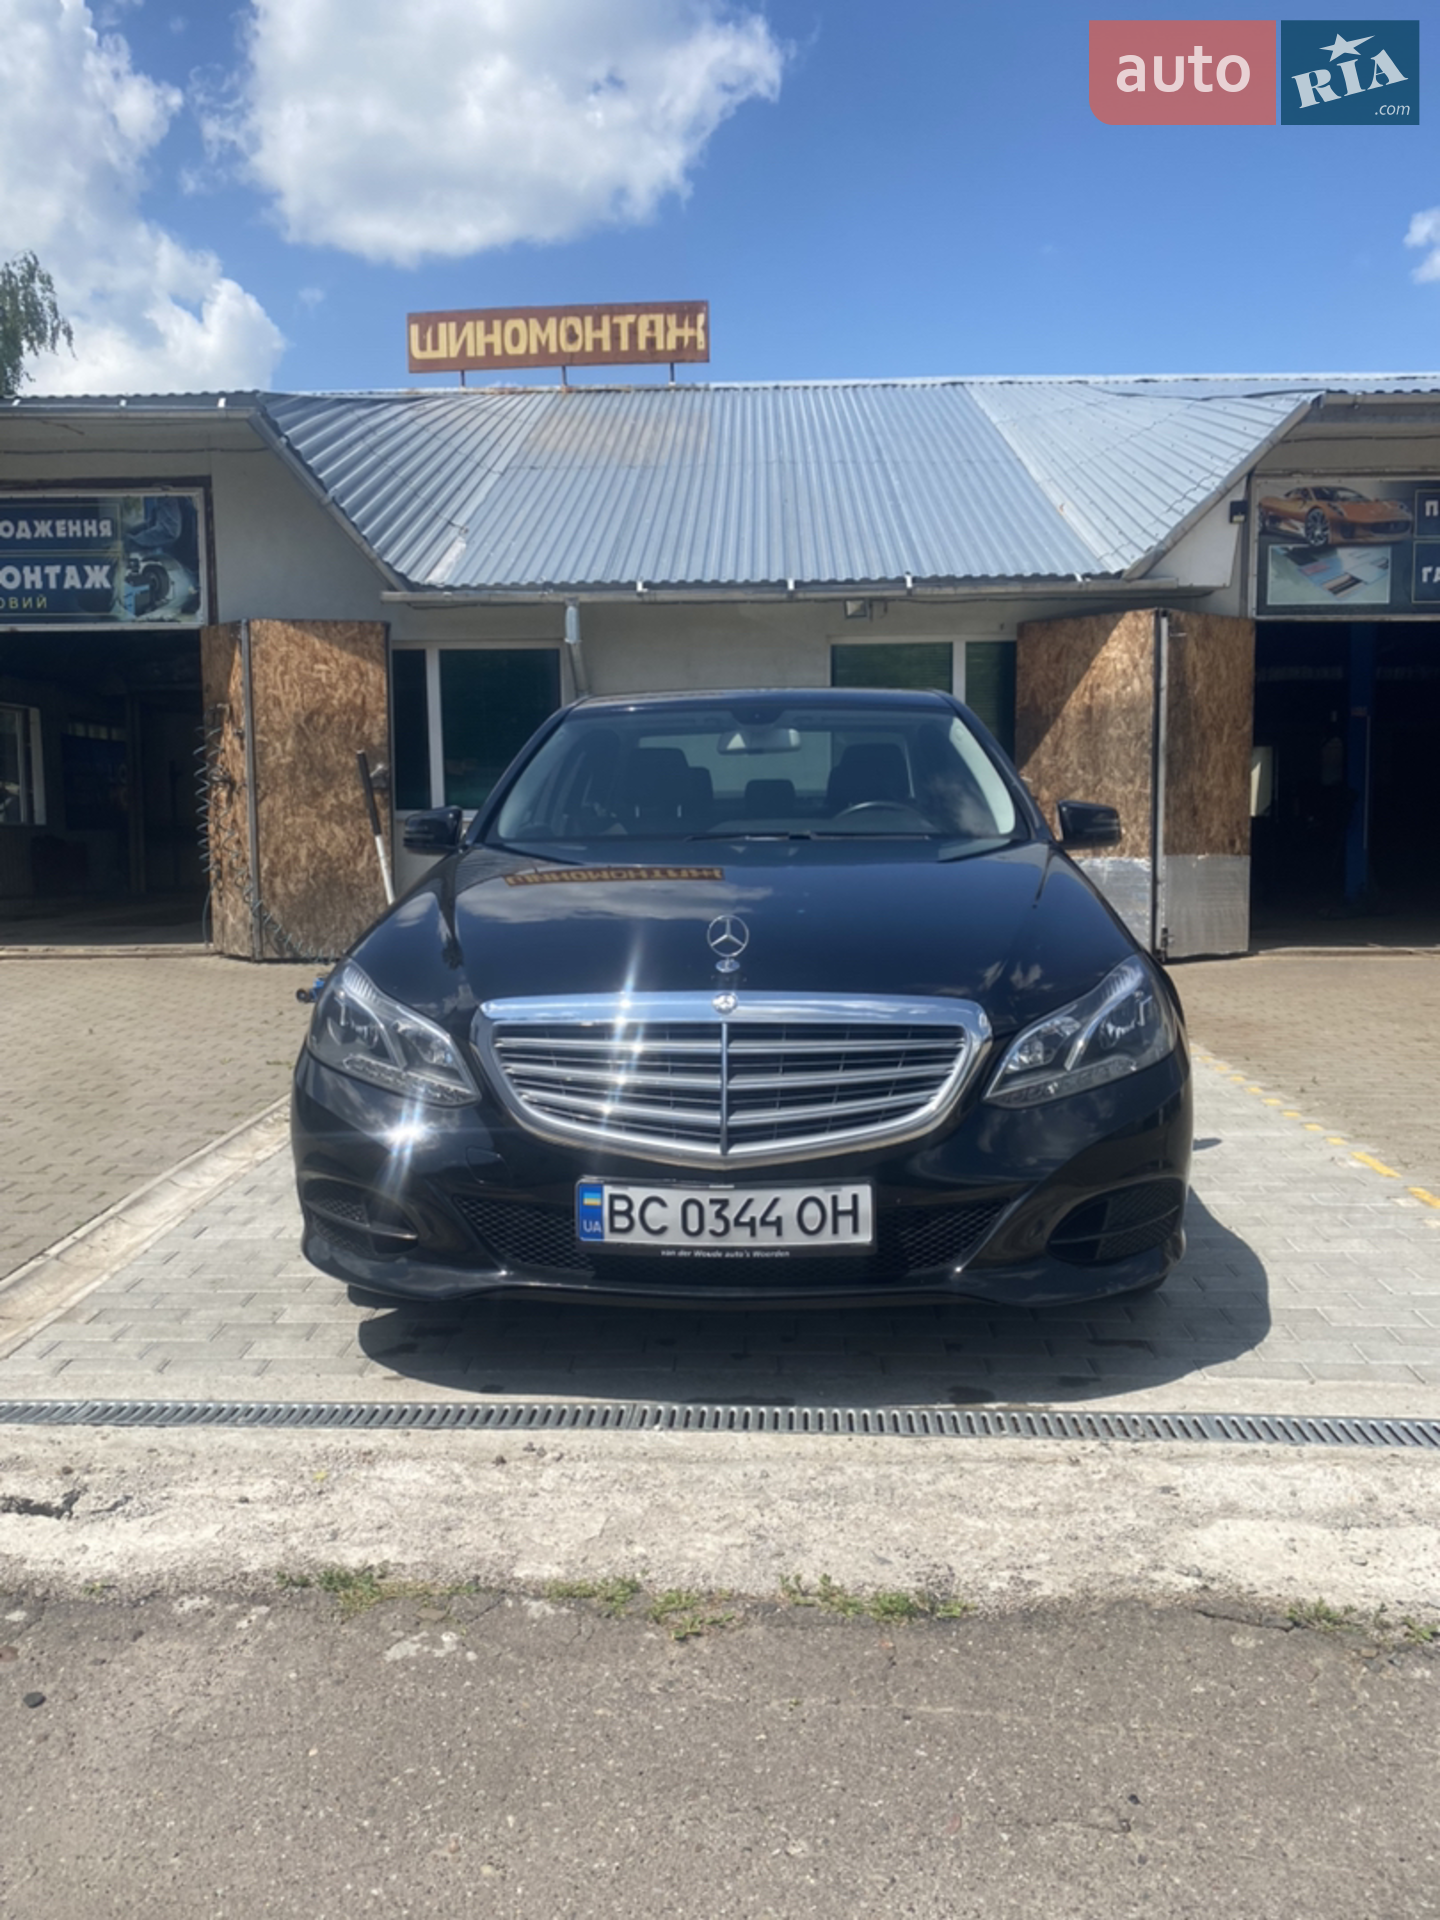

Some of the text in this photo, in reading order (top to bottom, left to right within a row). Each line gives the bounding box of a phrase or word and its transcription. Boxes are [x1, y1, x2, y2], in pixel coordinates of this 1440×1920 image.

[409, 312, 706, 360] ШИНОМОНТАЖ
[582, 1220, 602, 1233] UA
[608, 1193, 859, 1238] BC 0344 OH
